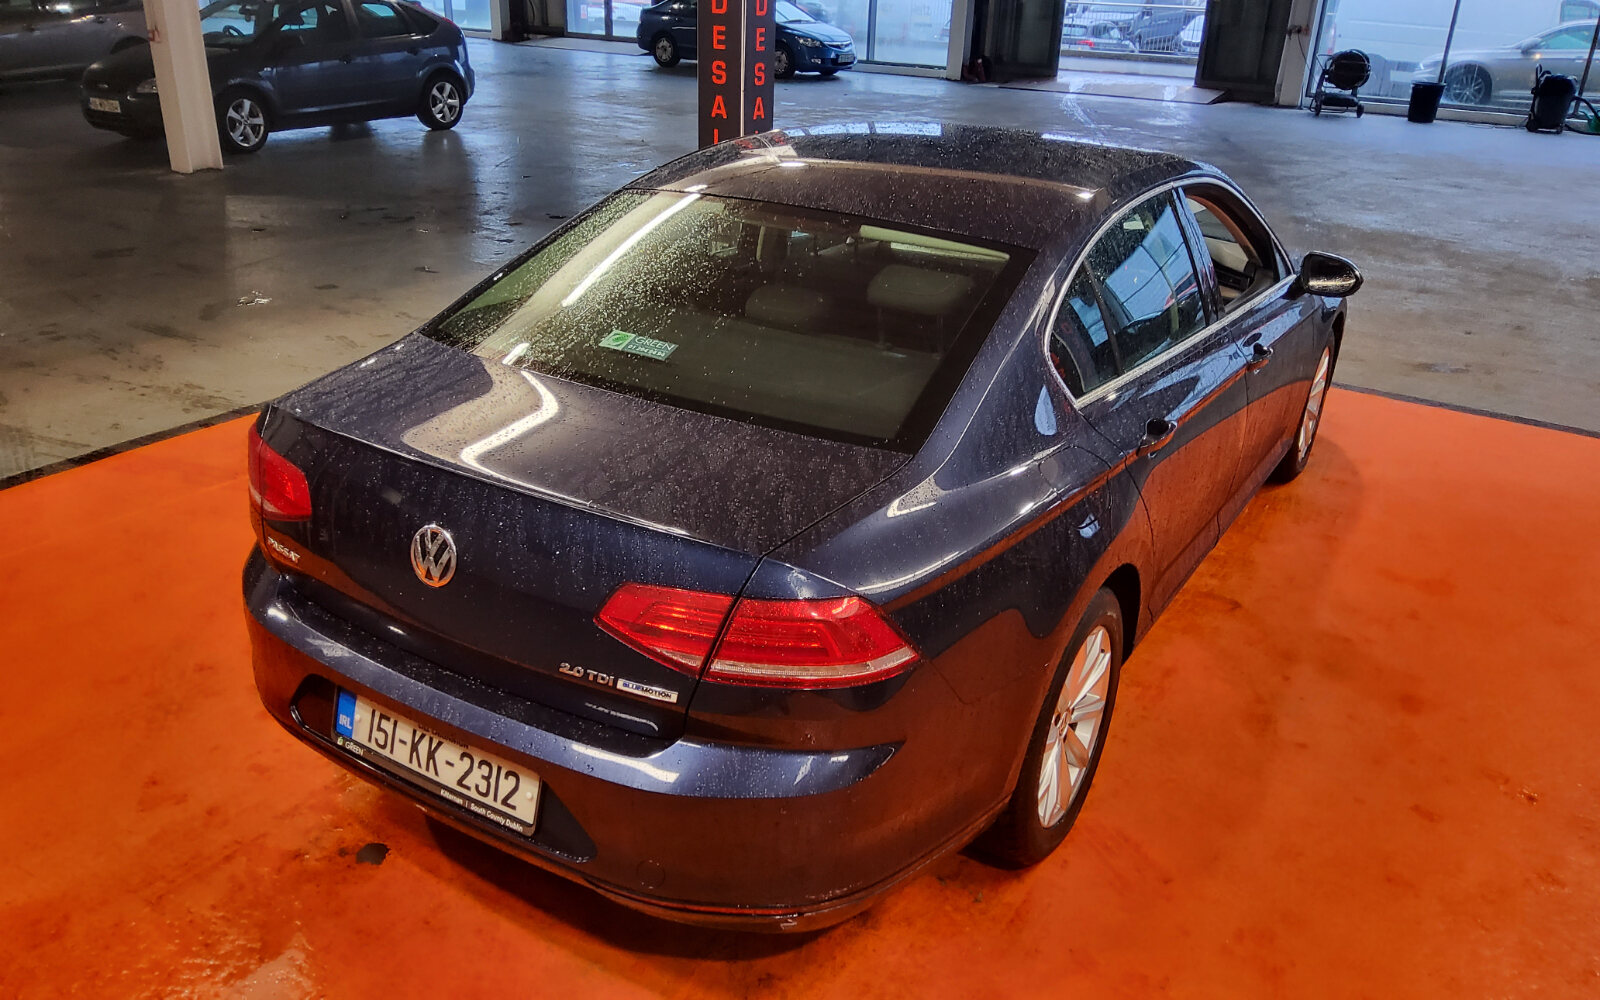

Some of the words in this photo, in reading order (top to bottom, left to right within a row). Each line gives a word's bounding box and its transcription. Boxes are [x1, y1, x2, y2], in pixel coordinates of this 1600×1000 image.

[753, 0, 768, 134] DESA
[635, 336, 676, 351] GREEN
[267, 536, 301, 564] PASSAT
[338, 713, 353, 730] IRL
[367, 708, 521, 811] 151-KK-2312
[470, 803, 487, 817] South
[487, 809, 505, 826] County
[505, 817, 524, 833] Dublin
